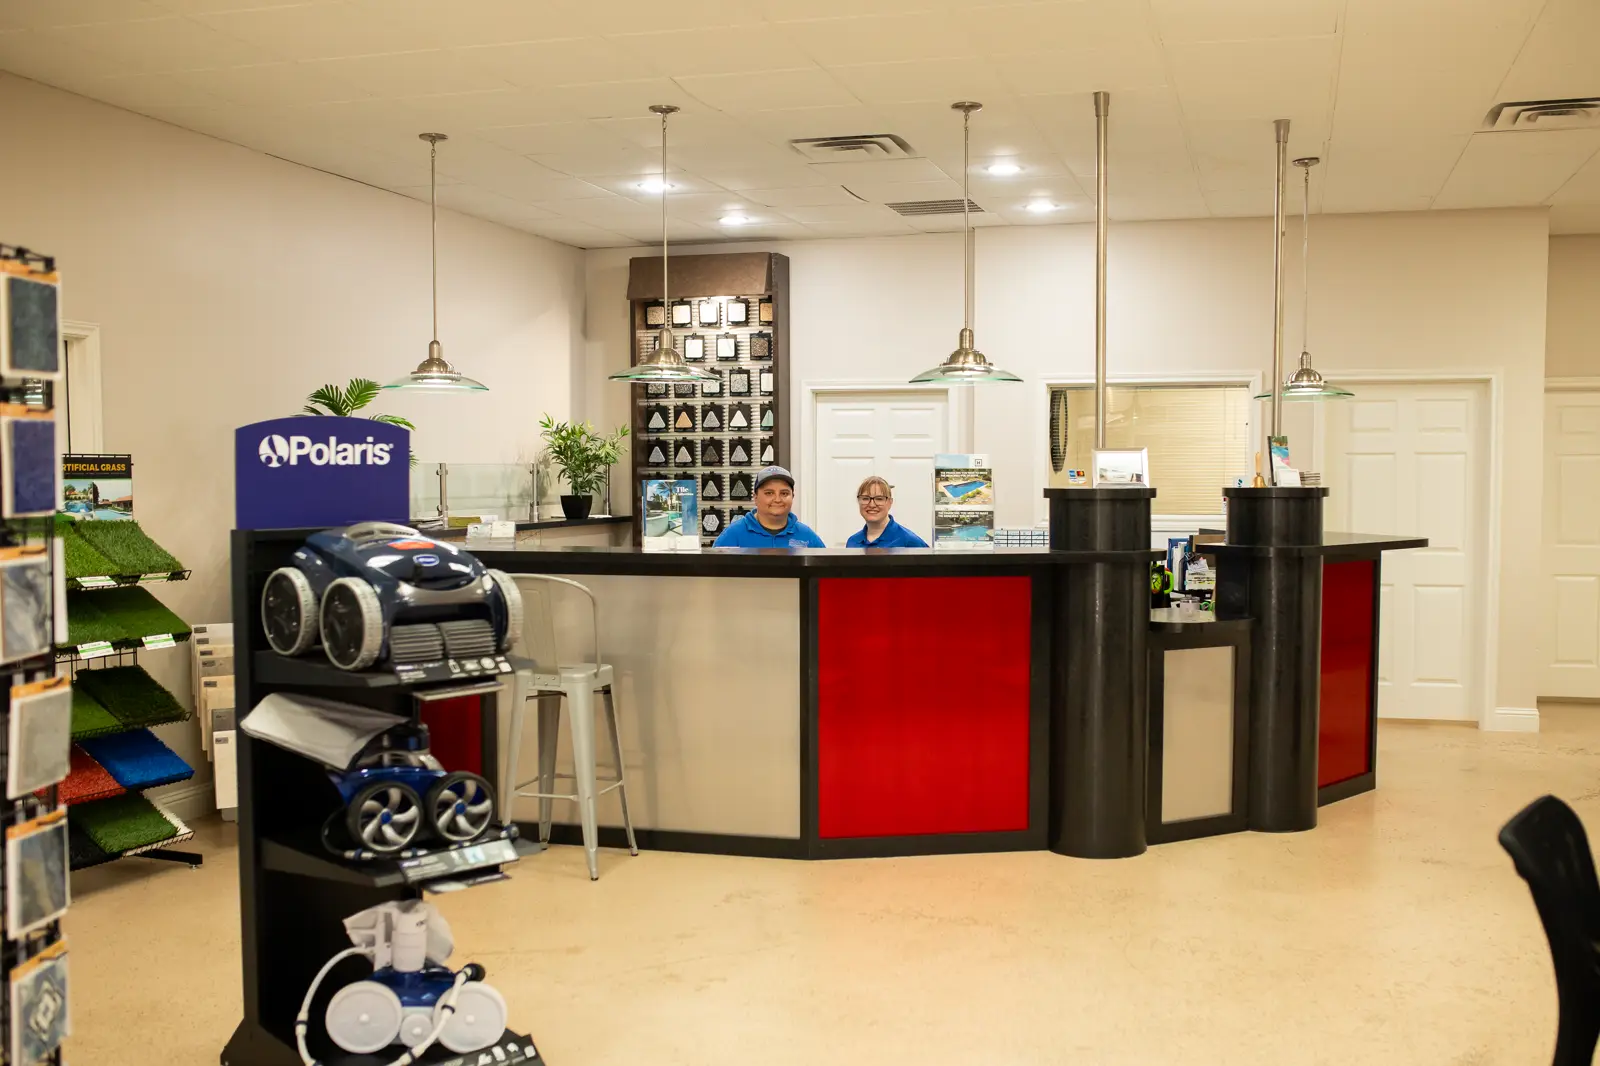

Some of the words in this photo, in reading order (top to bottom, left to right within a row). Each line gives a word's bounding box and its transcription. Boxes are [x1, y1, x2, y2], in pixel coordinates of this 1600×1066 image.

[289, 436, 393, 466] Polaris
[63, 463, 99, 472] RTIFICIAL
[100, 463, 126, 472] GRASS
